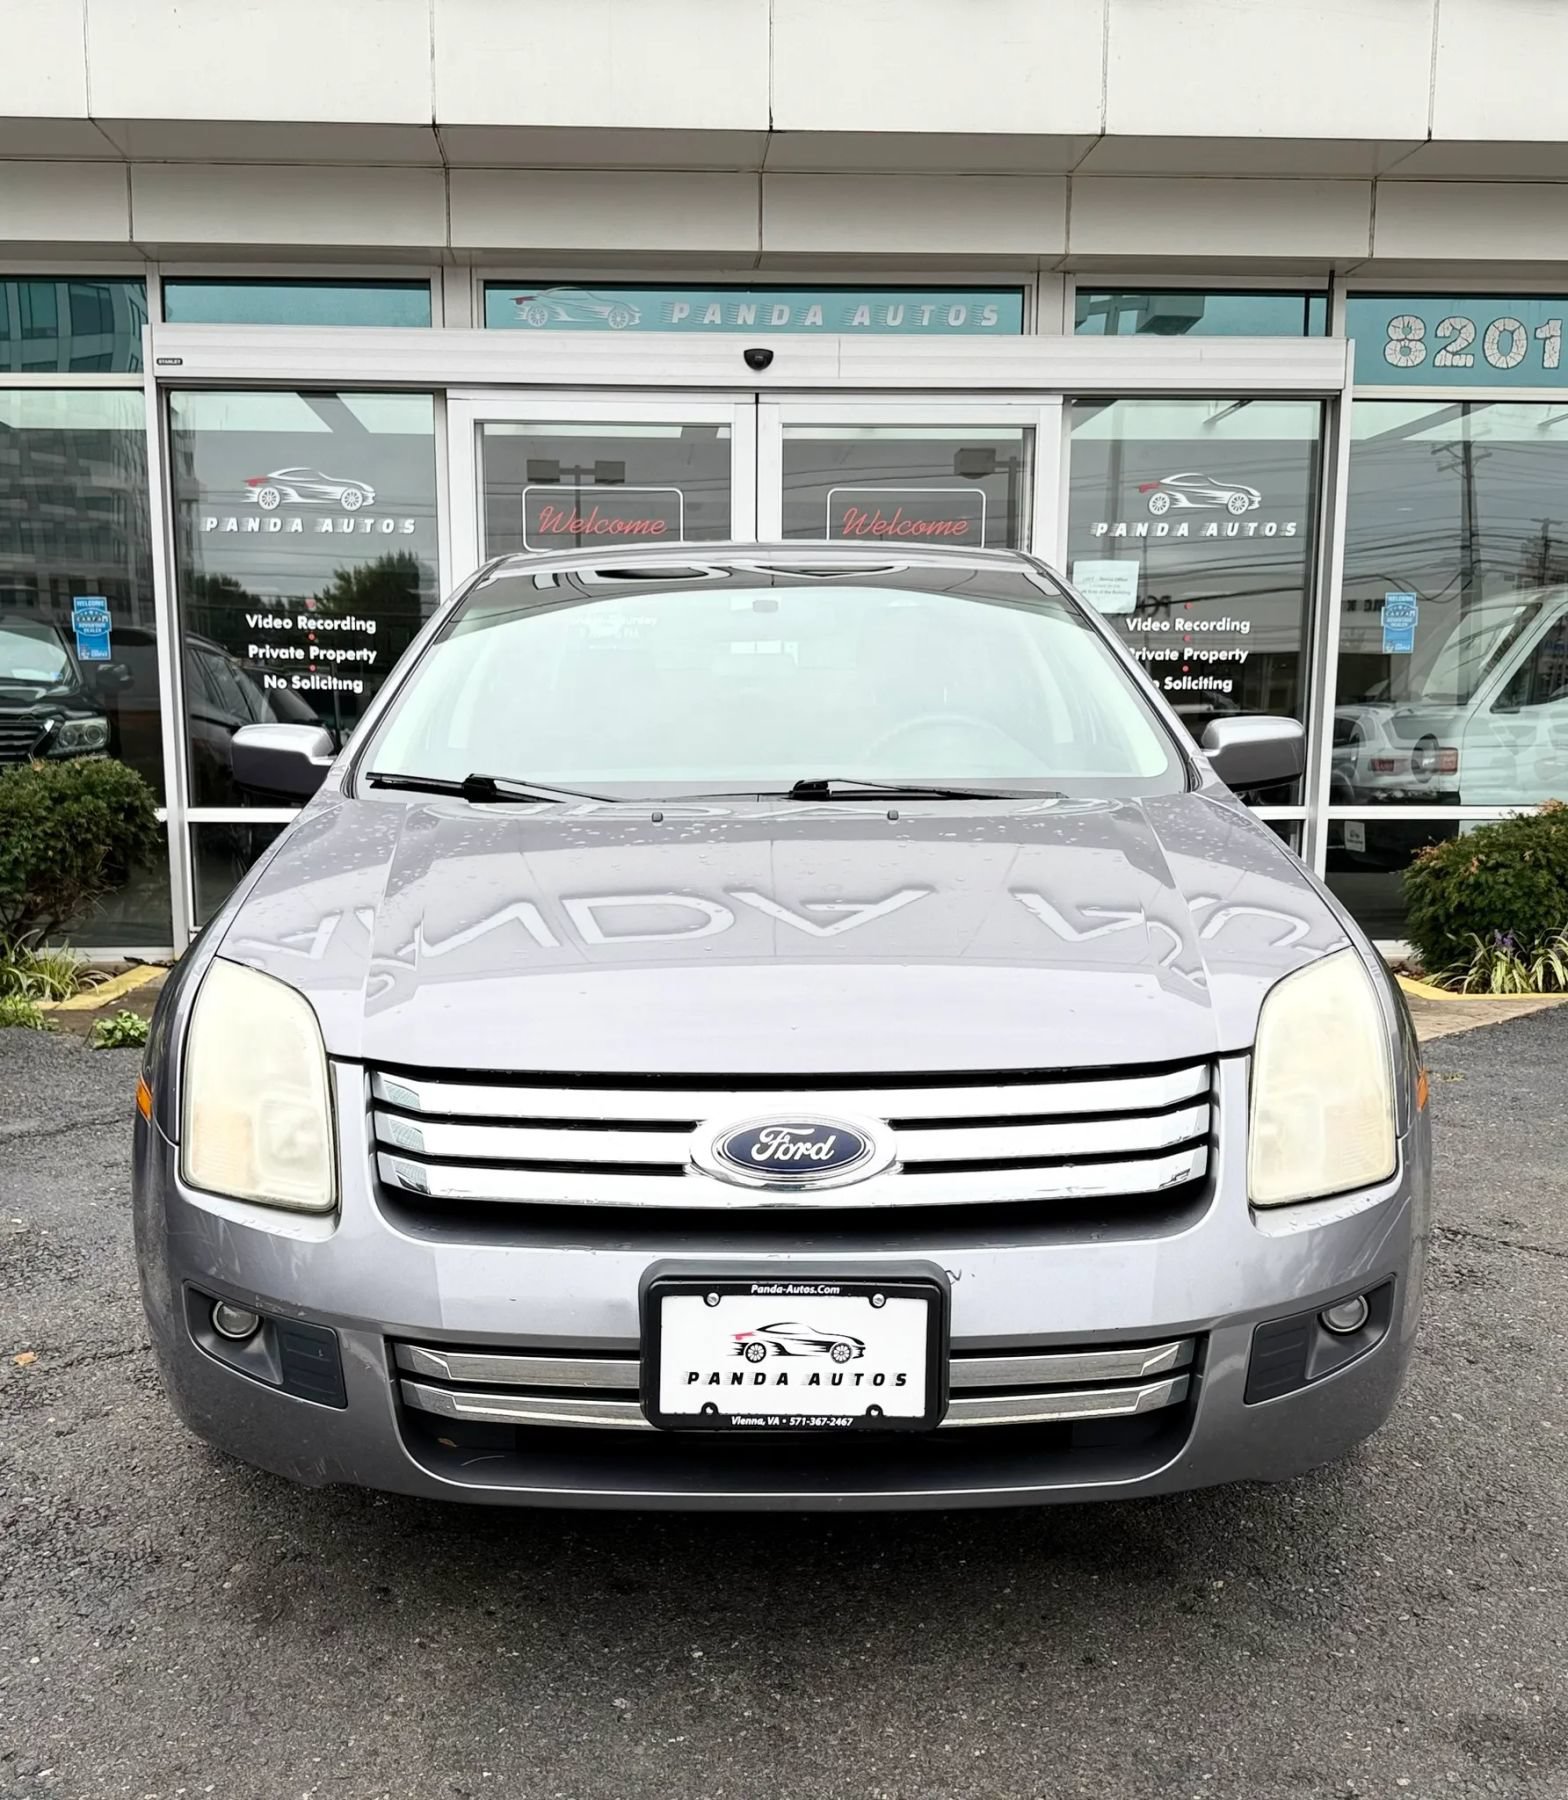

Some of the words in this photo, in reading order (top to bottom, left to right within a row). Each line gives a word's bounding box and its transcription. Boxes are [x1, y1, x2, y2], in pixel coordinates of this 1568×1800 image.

[664, 302, 825, 327] PANDA
[843, 303, 999, 328] AUTOS
[1383, 314, 1564, 369] 8201
[200, 516, 304, 533] PANDA
[316, 517, 416, 534] AUTOS
[538, 505, 668, 535] Welcome
[842, 506, 969, 536] Welcome
[1090, 521, 1190, 537] PANDA
[1201, 521, 1298, 537] AUTOS
[245, 613, 293, 630] Video
[297, 615, 377, 635] Recording
[1126, 617, 1170, 632] Video
[1174, 617, 1251, 635] Recording
[248, 644, 305, 660] Private
[309, 645, 378, 665] Property
[1183, 646, 1249, 664] Property
[263, 674, 288, 690] No
[291, 675, 364, 694] Soliciting
[1163, 676, 1233, 693] Soliciting
[750, 1125, 837, 1161] Ford
[751, 1284, 841, 1294] Panda-Autos.Com
[685, 1371, 789, 1386] PANDA
[805, 1372, 908, 1387] AUTOS
[731, 1416, 766, 1427] Vienna,
[767, 1416, 780, 1426] VA
[788, 1416, 854, 1427] 571-367-2467
